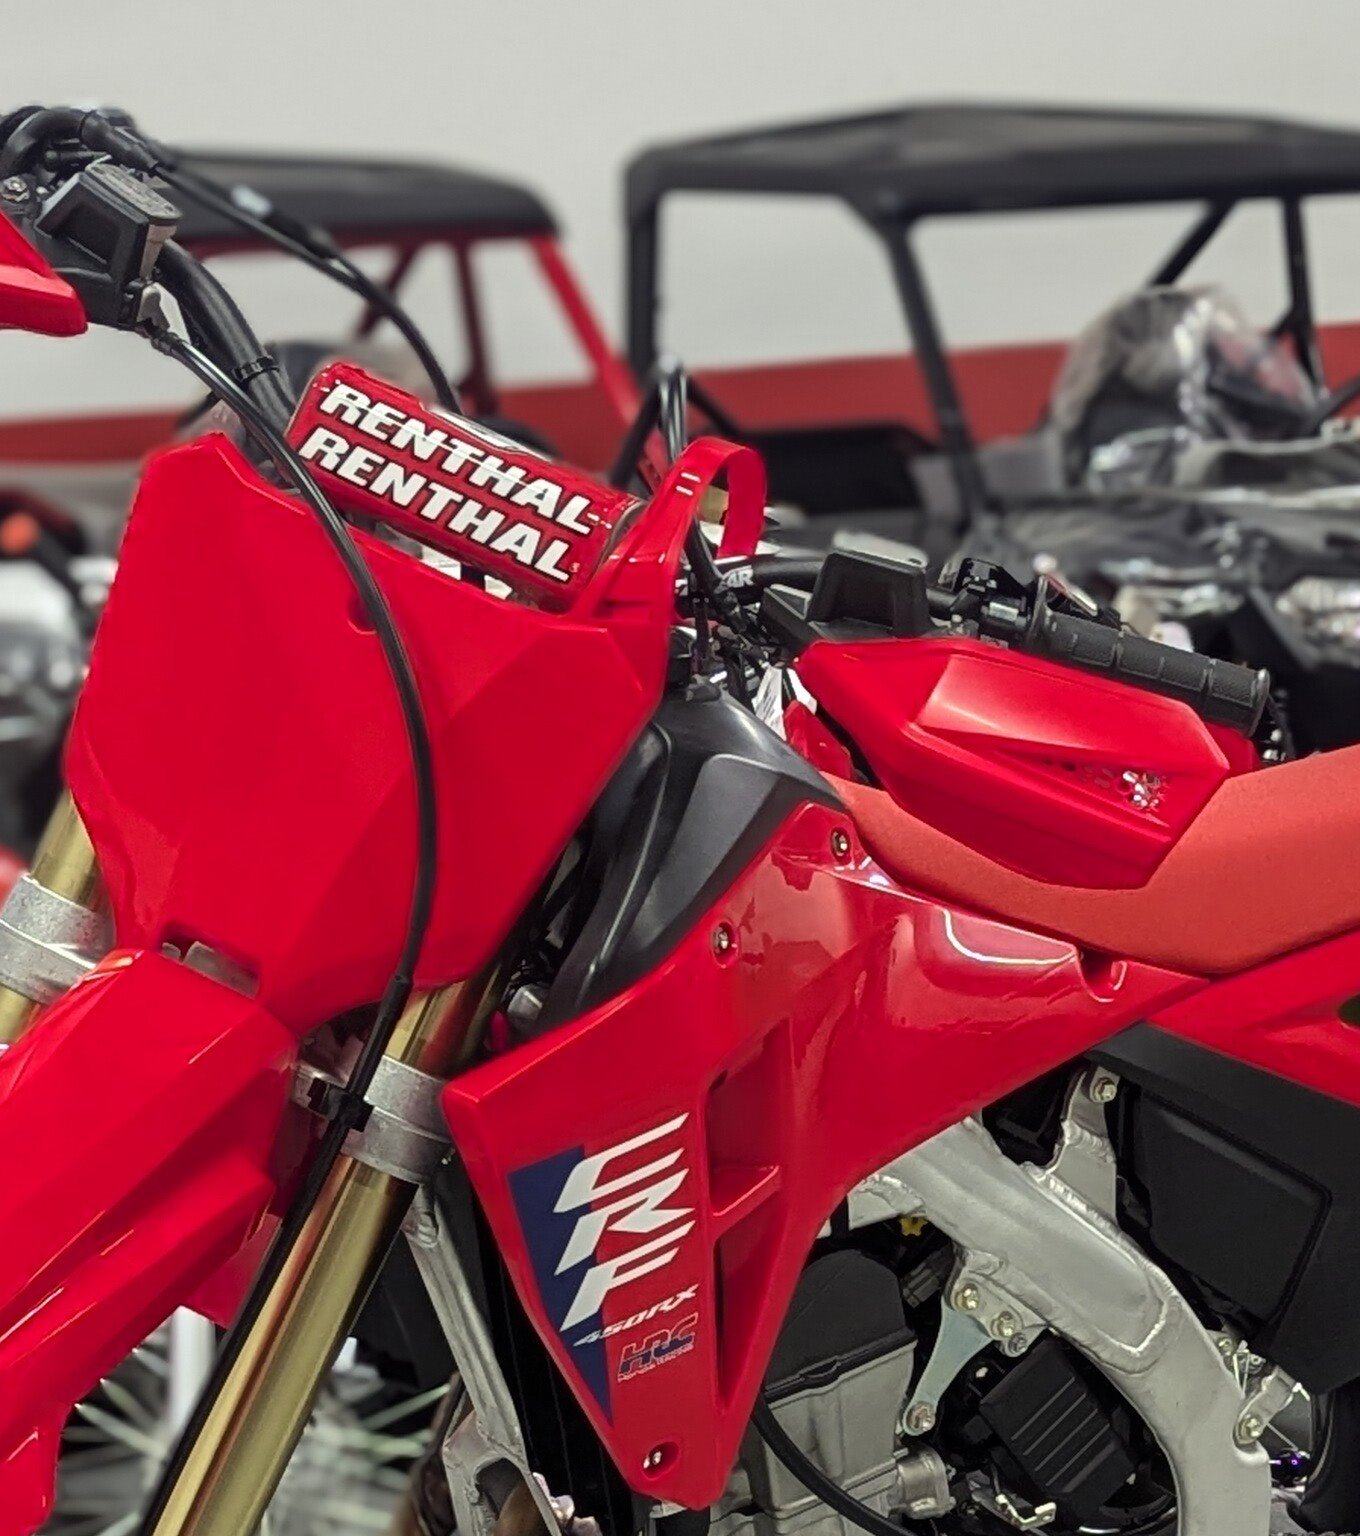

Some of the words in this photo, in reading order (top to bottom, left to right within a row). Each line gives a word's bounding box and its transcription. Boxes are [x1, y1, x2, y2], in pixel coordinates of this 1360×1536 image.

[298, 426, 573, 582] RENTHAL
[319, 382, 595, 536] RENTHAL
[553, 1111, 696, 1333] CRF
[572, 1283, 699, 1347] 450RX
[619, 1312, 700, 1376] HRC
